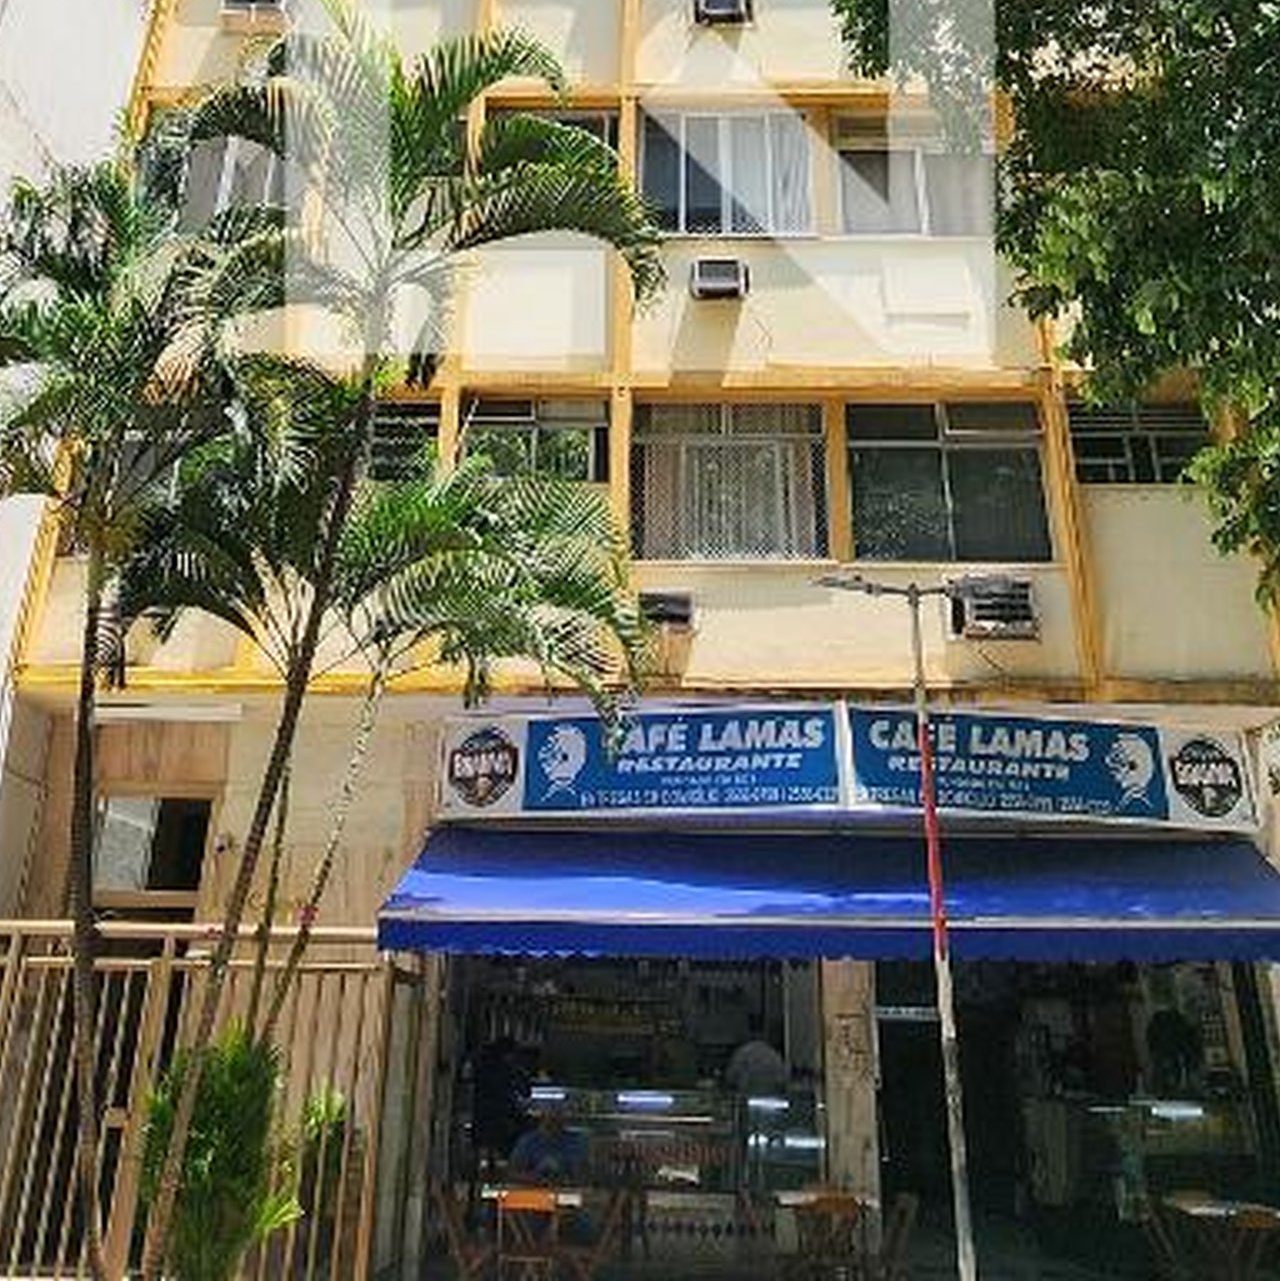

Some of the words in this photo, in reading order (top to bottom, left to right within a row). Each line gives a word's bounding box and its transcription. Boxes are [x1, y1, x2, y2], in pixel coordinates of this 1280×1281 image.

[698, 718, 825, 752] LAMAS
[870, 716, 956, 752] CAÉ
[970, 725, 1090, 762] LAMAS
